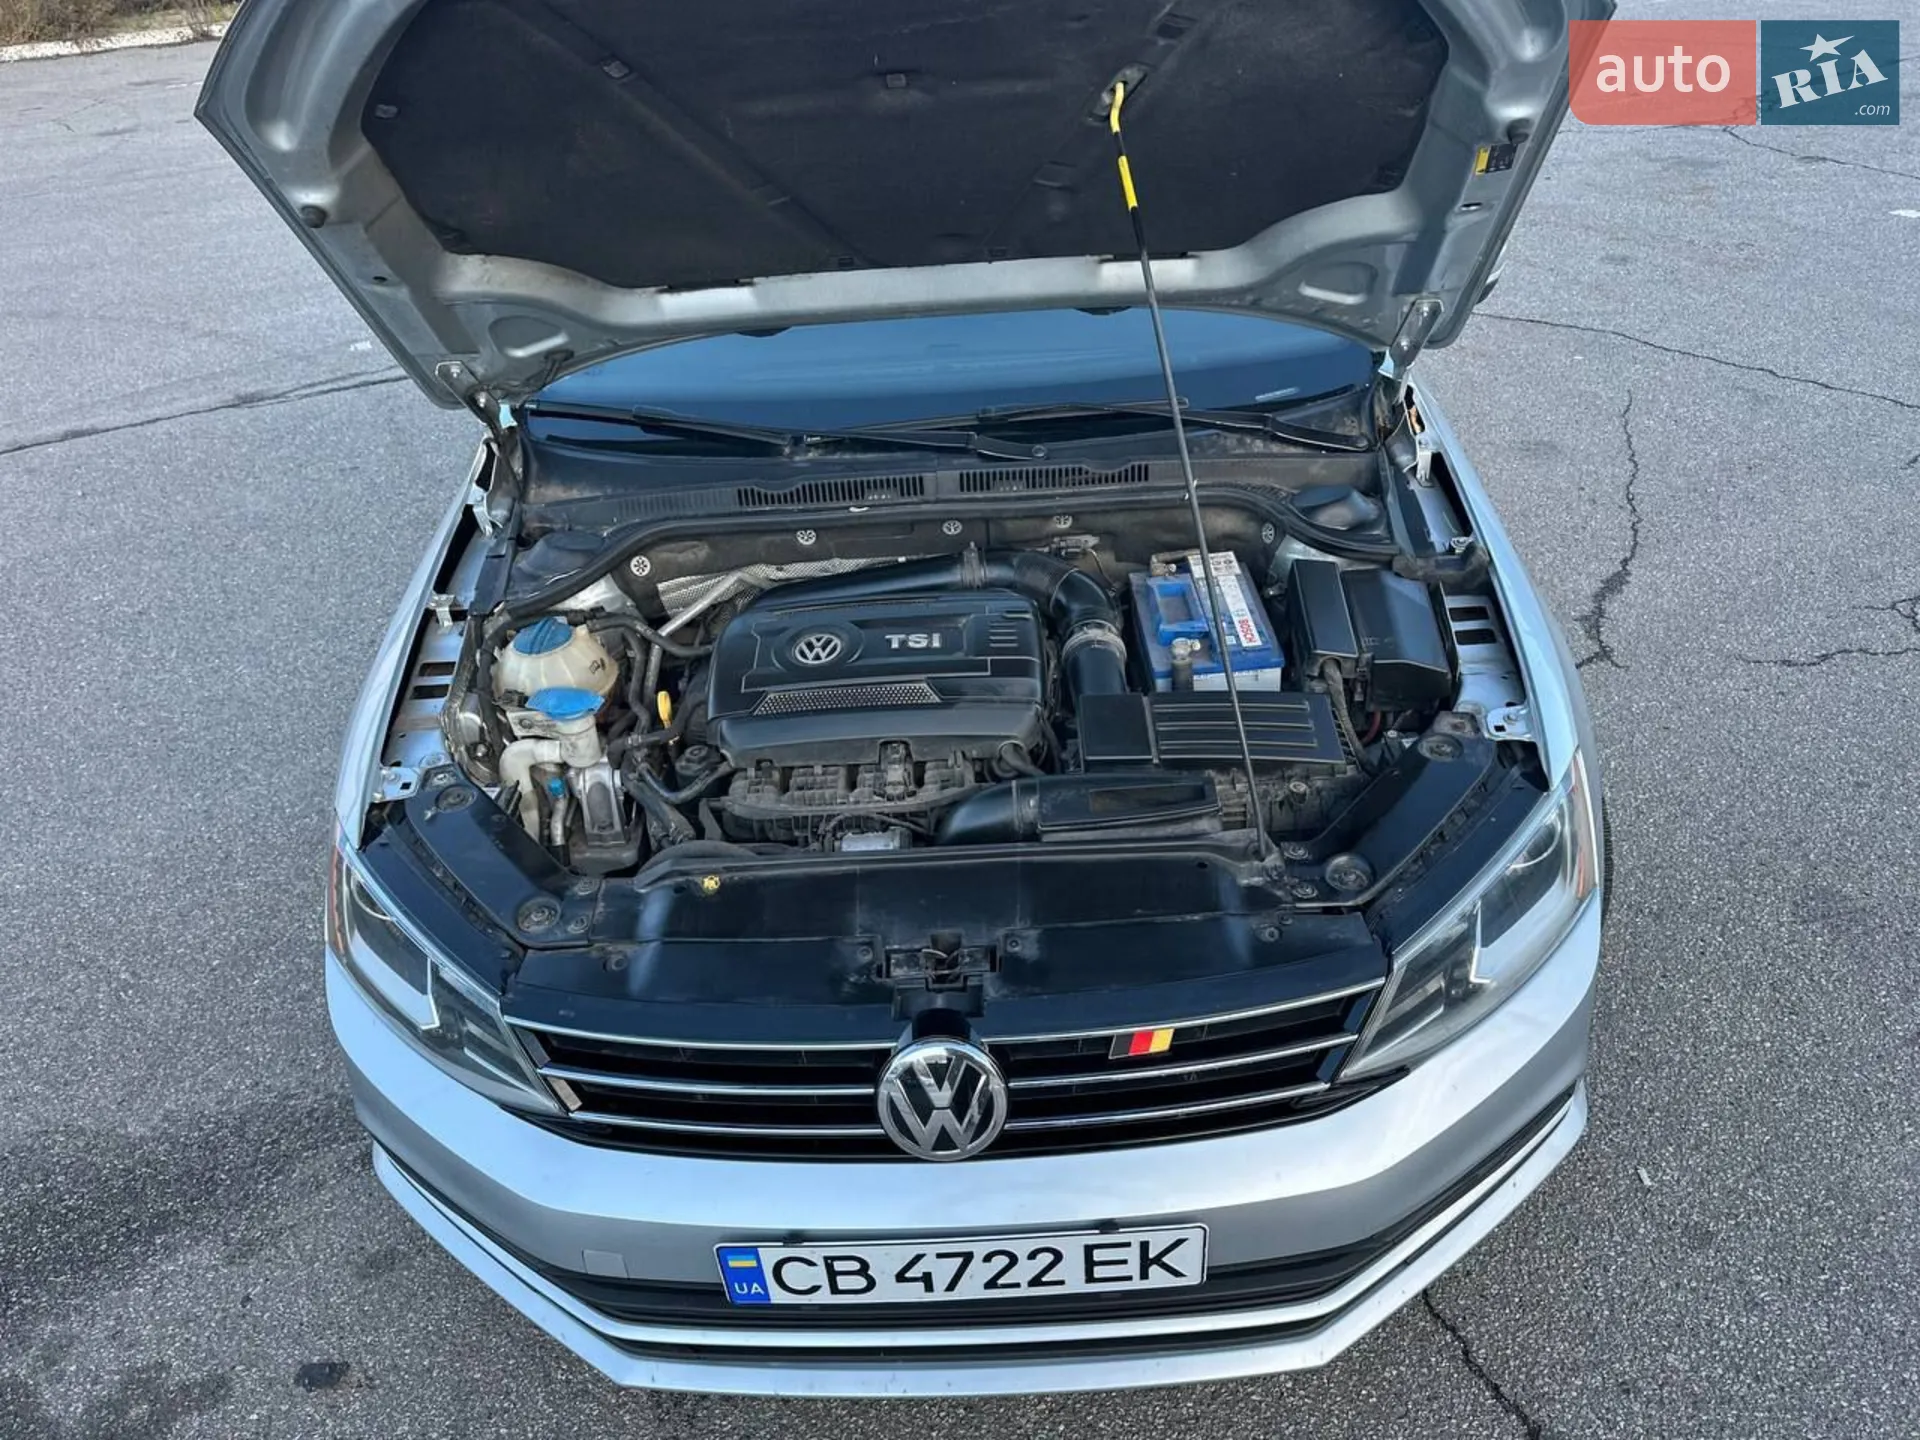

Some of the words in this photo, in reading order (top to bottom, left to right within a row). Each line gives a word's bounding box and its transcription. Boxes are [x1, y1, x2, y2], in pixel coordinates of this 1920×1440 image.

[885, 632, 942, 649] TSI
[1238, 617, 1257, 644] BOSCH
[772, 1254, 877, 1296] CB
[894, 1246, 1066, 1293] 4722
[1083, 1237, 1190, 1285] EK
[734, 1282, 765, 1295] UA
